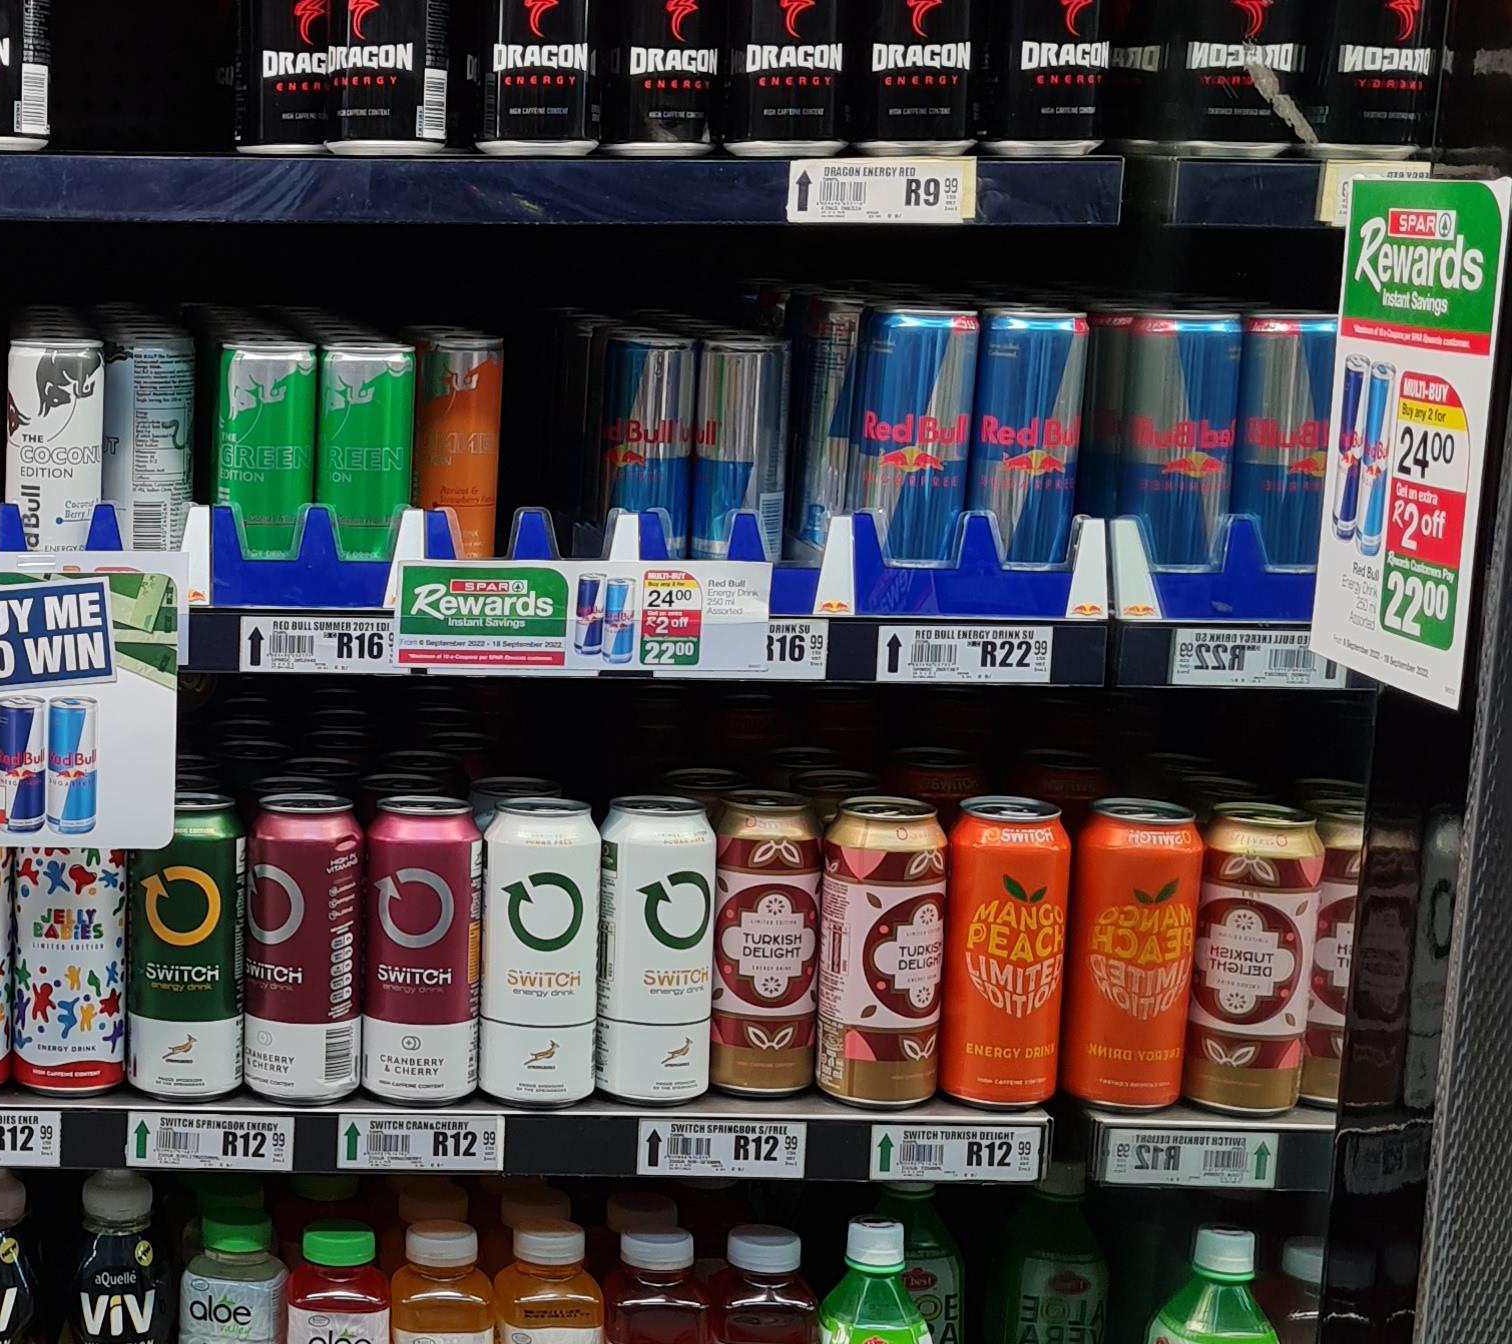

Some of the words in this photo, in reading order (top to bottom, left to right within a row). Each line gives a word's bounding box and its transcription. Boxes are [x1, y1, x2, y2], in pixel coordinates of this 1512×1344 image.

[493, 43, 588, 73] DRAGON
[746, 42, 842, 72] DRAGON
[504, 75, 577, 86] ENERGY
[824, 167, 861, 177] DRAGON
[863, 167, 896, 177] ENERGY
[898, 167, 915, 177] RED
[905, 178, 940, 206] R9
[944, 178, 958, 194] 99
[1398, 215, 1435, 234] SPAR
[1355, 217, 1483, 291] Rewards
[1382, 290, 1408, 308] Instant
[1411, 294, 1447, 316] Savings
[1403, 378, 1449, 402] MULTI-BUY
[864, 412, 913, 443] Red
[919, 416, 970, 445] Bull
[221, 446, 311, 470] GREEN
[21, 468, 73, 478] EDITION
[1422, 510, 1446, 538] off
[465, 582, 509, 591] SPAR
[45, 593, 102, 630] ME
[414, 584, 553, 619] Rewards
[448, 618, 482, 627] Instant
[486, 618, 525, 628] Savings
[29, 632, 104, 675] WIN
[973, 904, 1064, 928] MANGO
[743, 933, 802, 946] TURKISH
[743, 946, 801, 959] DELIGHT
[146, 963, 218, 983] SWITCH
[507, 971, 580, 989] SWITCH
[190, 1296, 251, 1325] aloe
